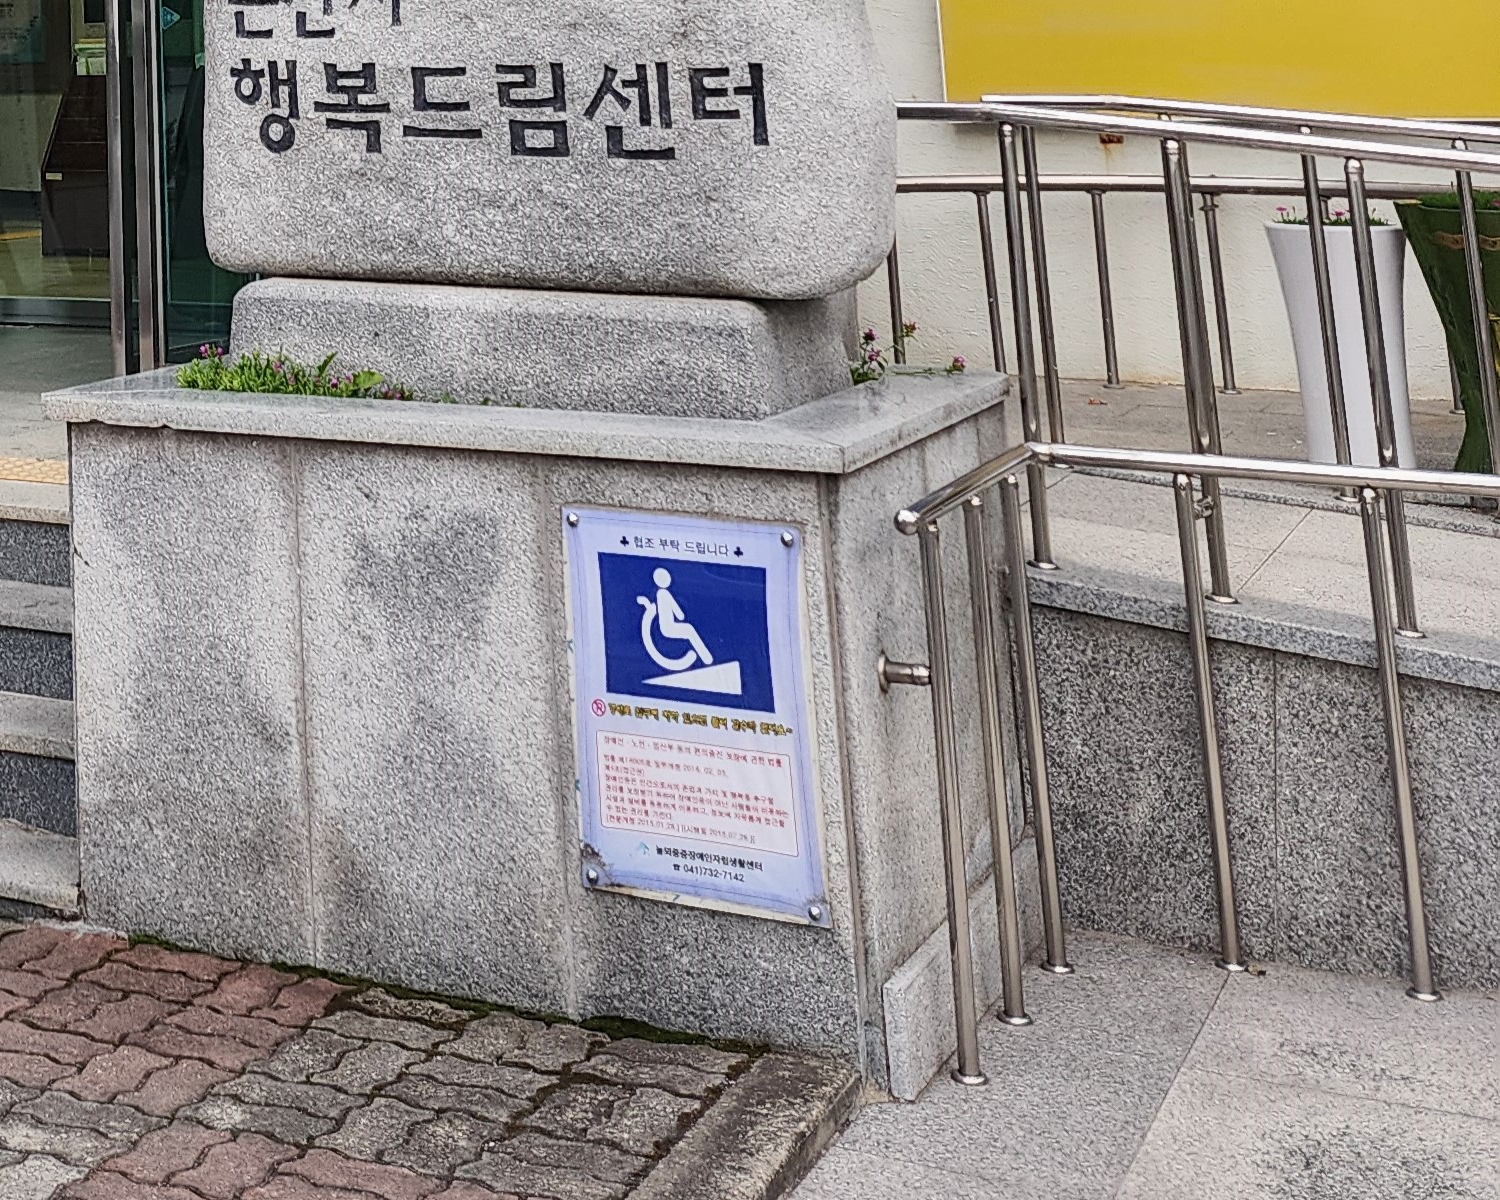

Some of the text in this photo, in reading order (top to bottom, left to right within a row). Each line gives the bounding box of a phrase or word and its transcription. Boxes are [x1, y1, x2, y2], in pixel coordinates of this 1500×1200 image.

[230, 58, 770, 161] 행복드림센터
[633, 536, 729, 557] 협조 부탁 드립니다
[683, 864, 745, 882] 041)732-7142
